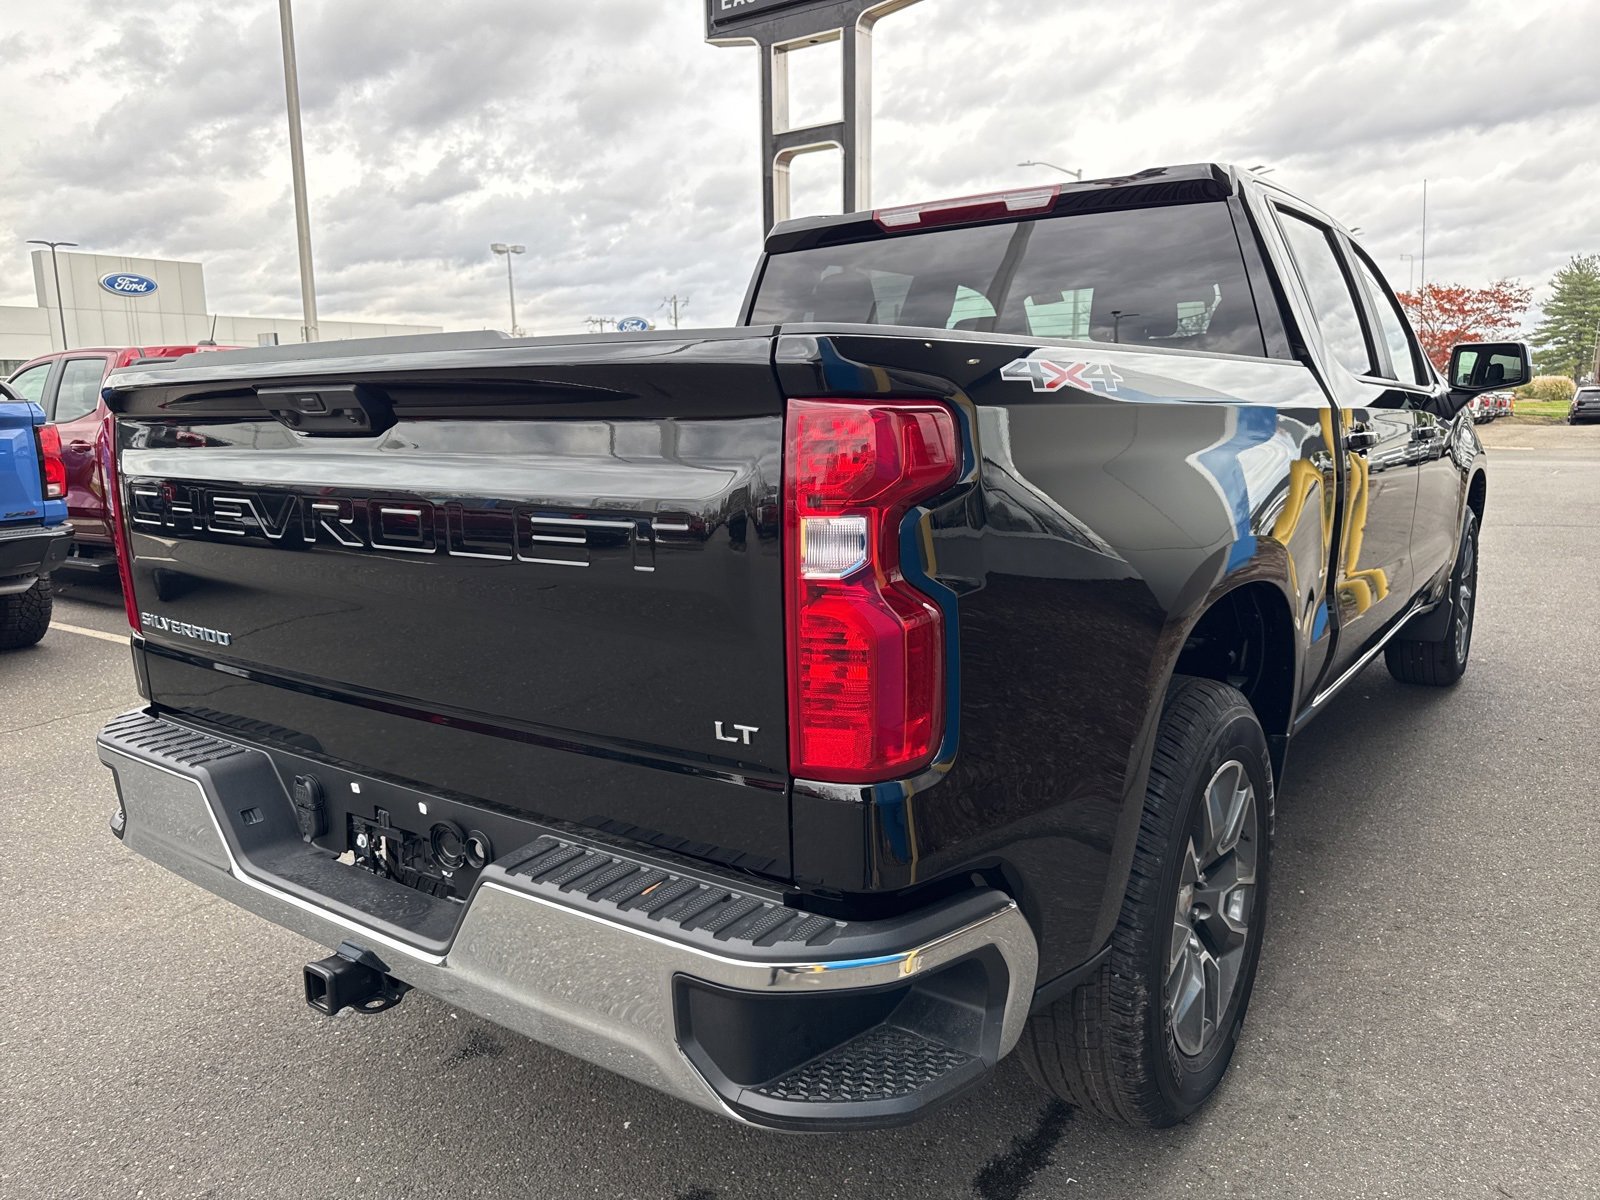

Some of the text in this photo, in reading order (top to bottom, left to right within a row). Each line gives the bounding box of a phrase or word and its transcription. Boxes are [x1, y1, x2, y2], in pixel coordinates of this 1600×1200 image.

[114, 276, 147, 292] Ford
[129, 482, 692, 571] CHEVROLET
[141, 611, 231, 646] SILVERADO
[714, 720, 760, 745] LT
